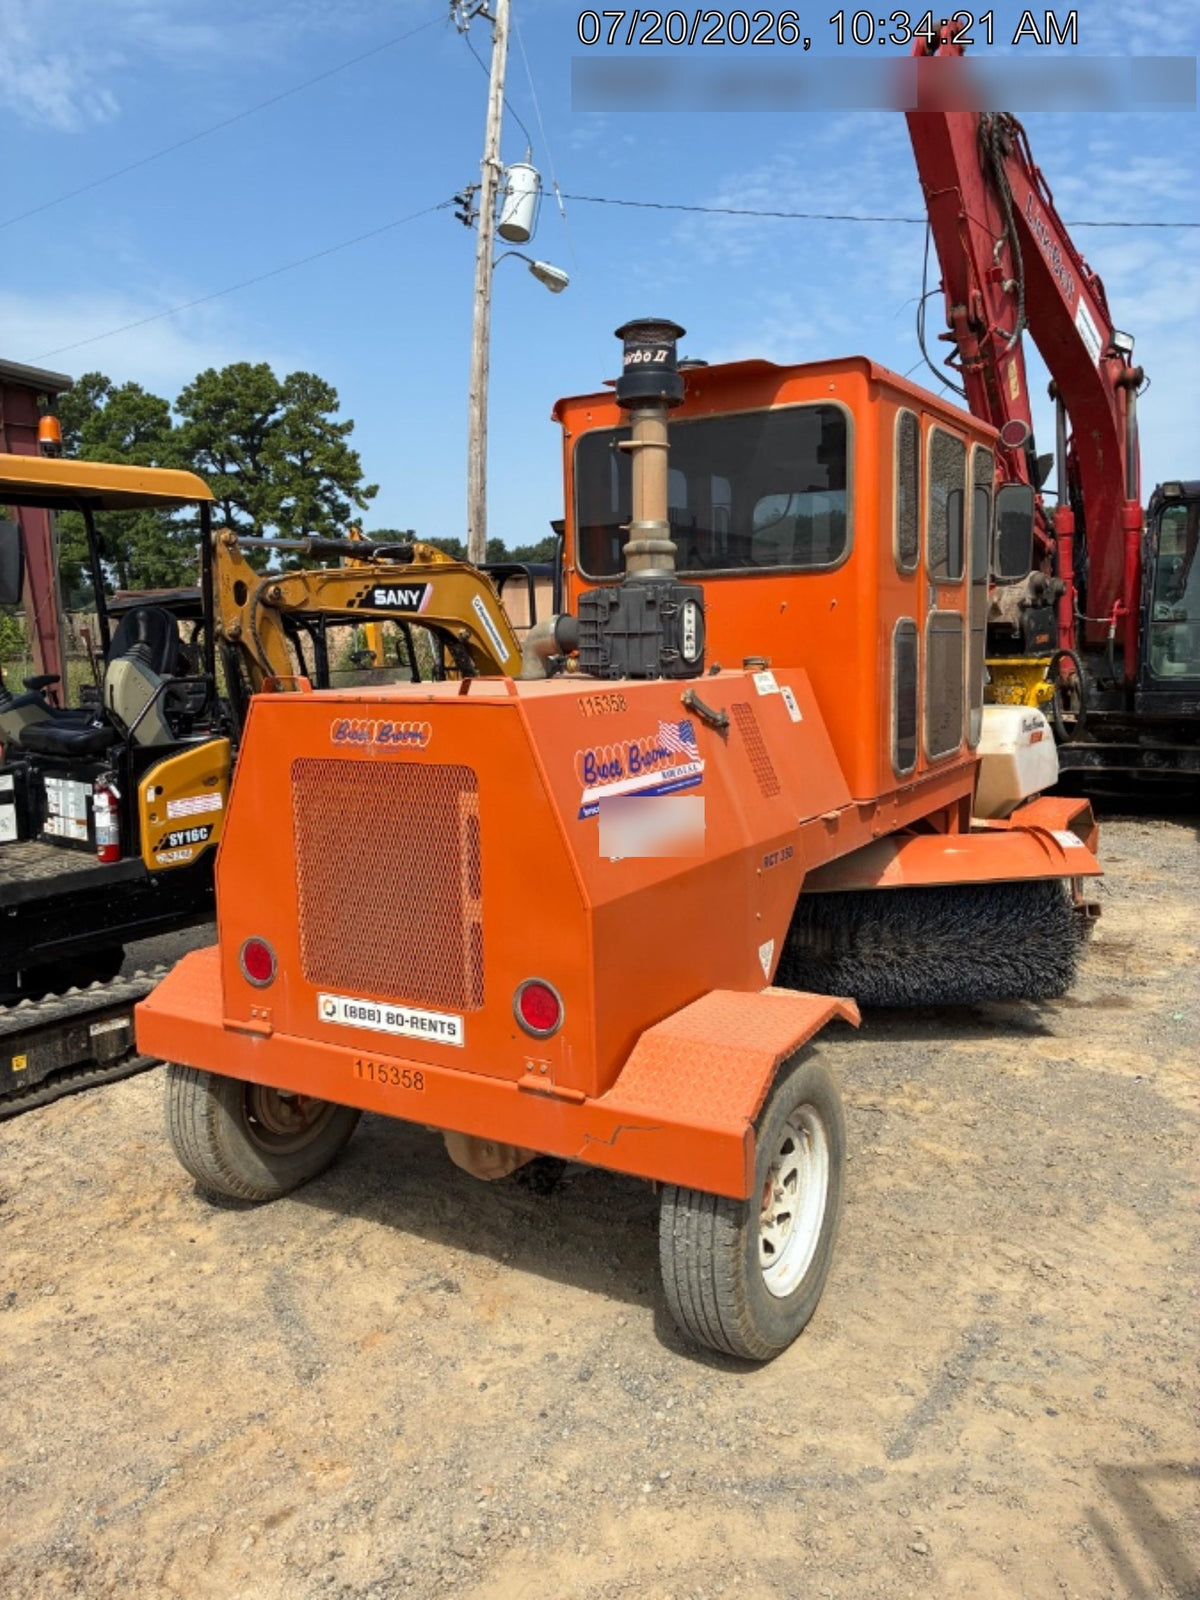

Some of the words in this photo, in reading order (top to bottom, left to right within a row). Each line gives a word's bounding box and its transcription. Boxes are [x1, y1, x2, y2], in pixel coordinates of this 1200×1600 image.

[374, 589, 420, 605] SANY
[578, 693, 626, 717] 115358
[628, 744, 671, 773] Broom
[169, 827, 208, 846] SY16C
[344, 1004, 381, 1024] (888)
[386, 1011, 456, 1036] 80-RENTS
[355, 1059, 424, 1091] 115358
